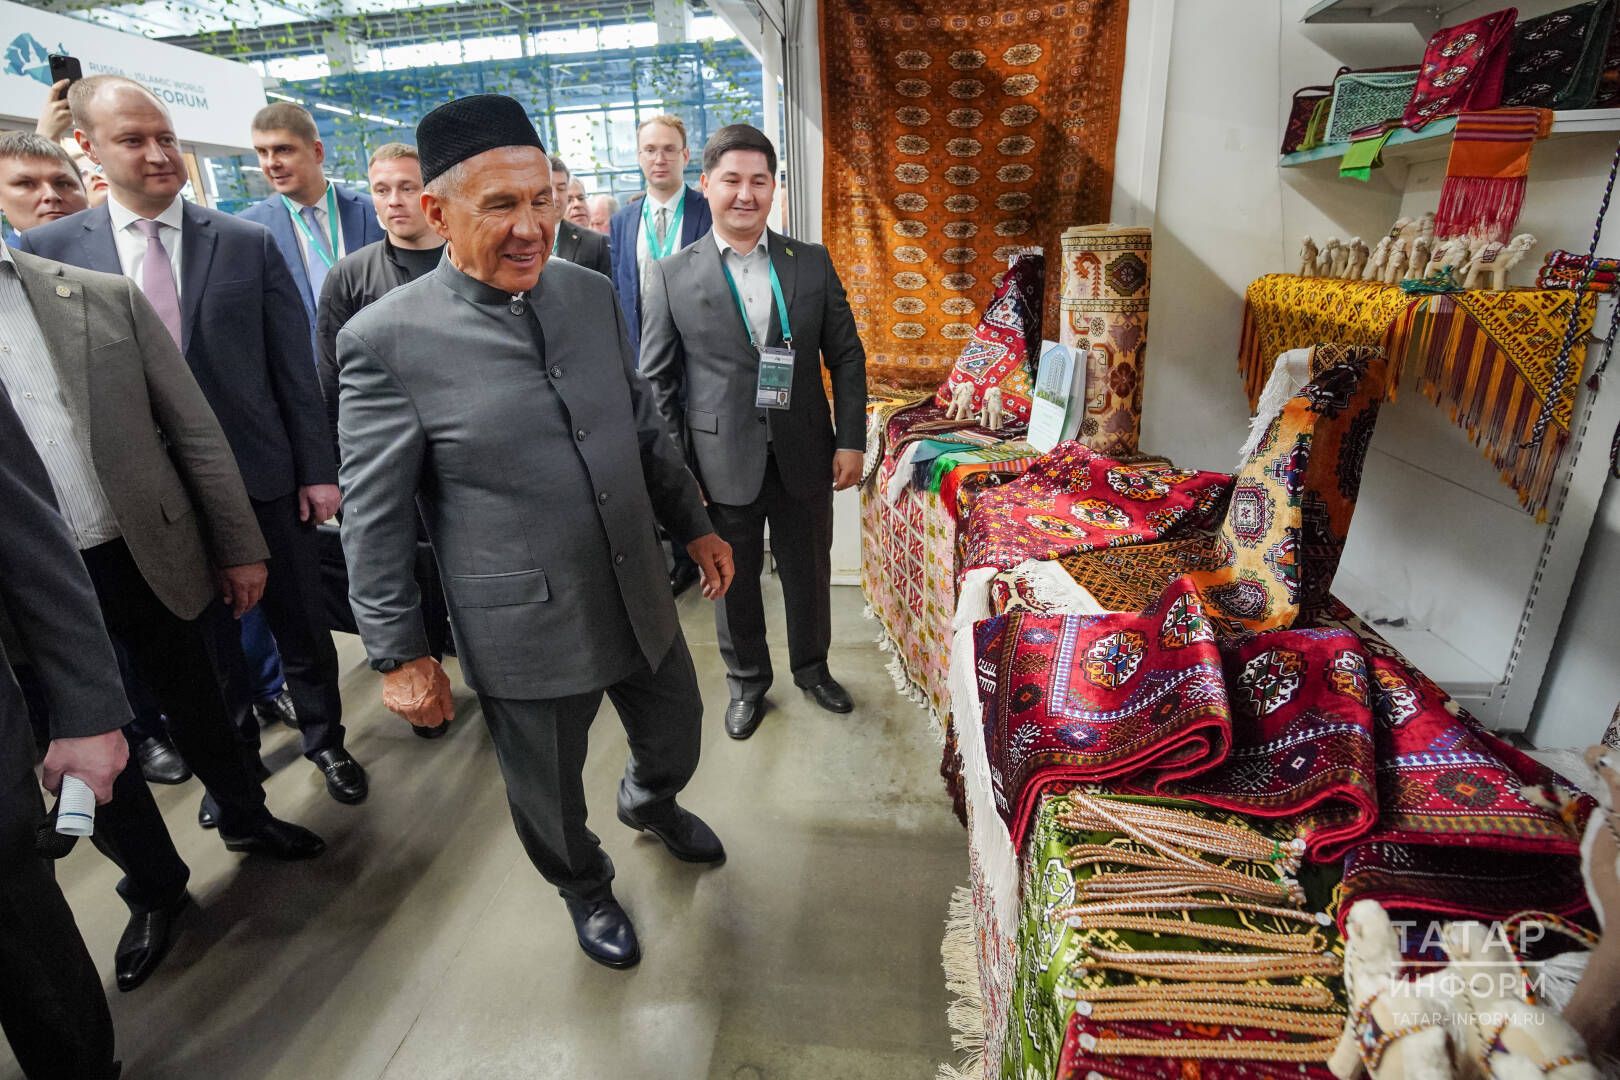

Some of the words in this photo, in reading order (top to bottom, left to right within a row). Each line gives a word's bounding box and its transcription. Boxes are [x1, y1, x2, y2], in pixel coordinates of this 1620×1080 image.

[89, 61, 126, 77] RUSSIA
[134, 72, 171, 87] ISLAMIC
[174, 80, 206, 94] WORLD
[152, 86, 209, 110] FORUM
